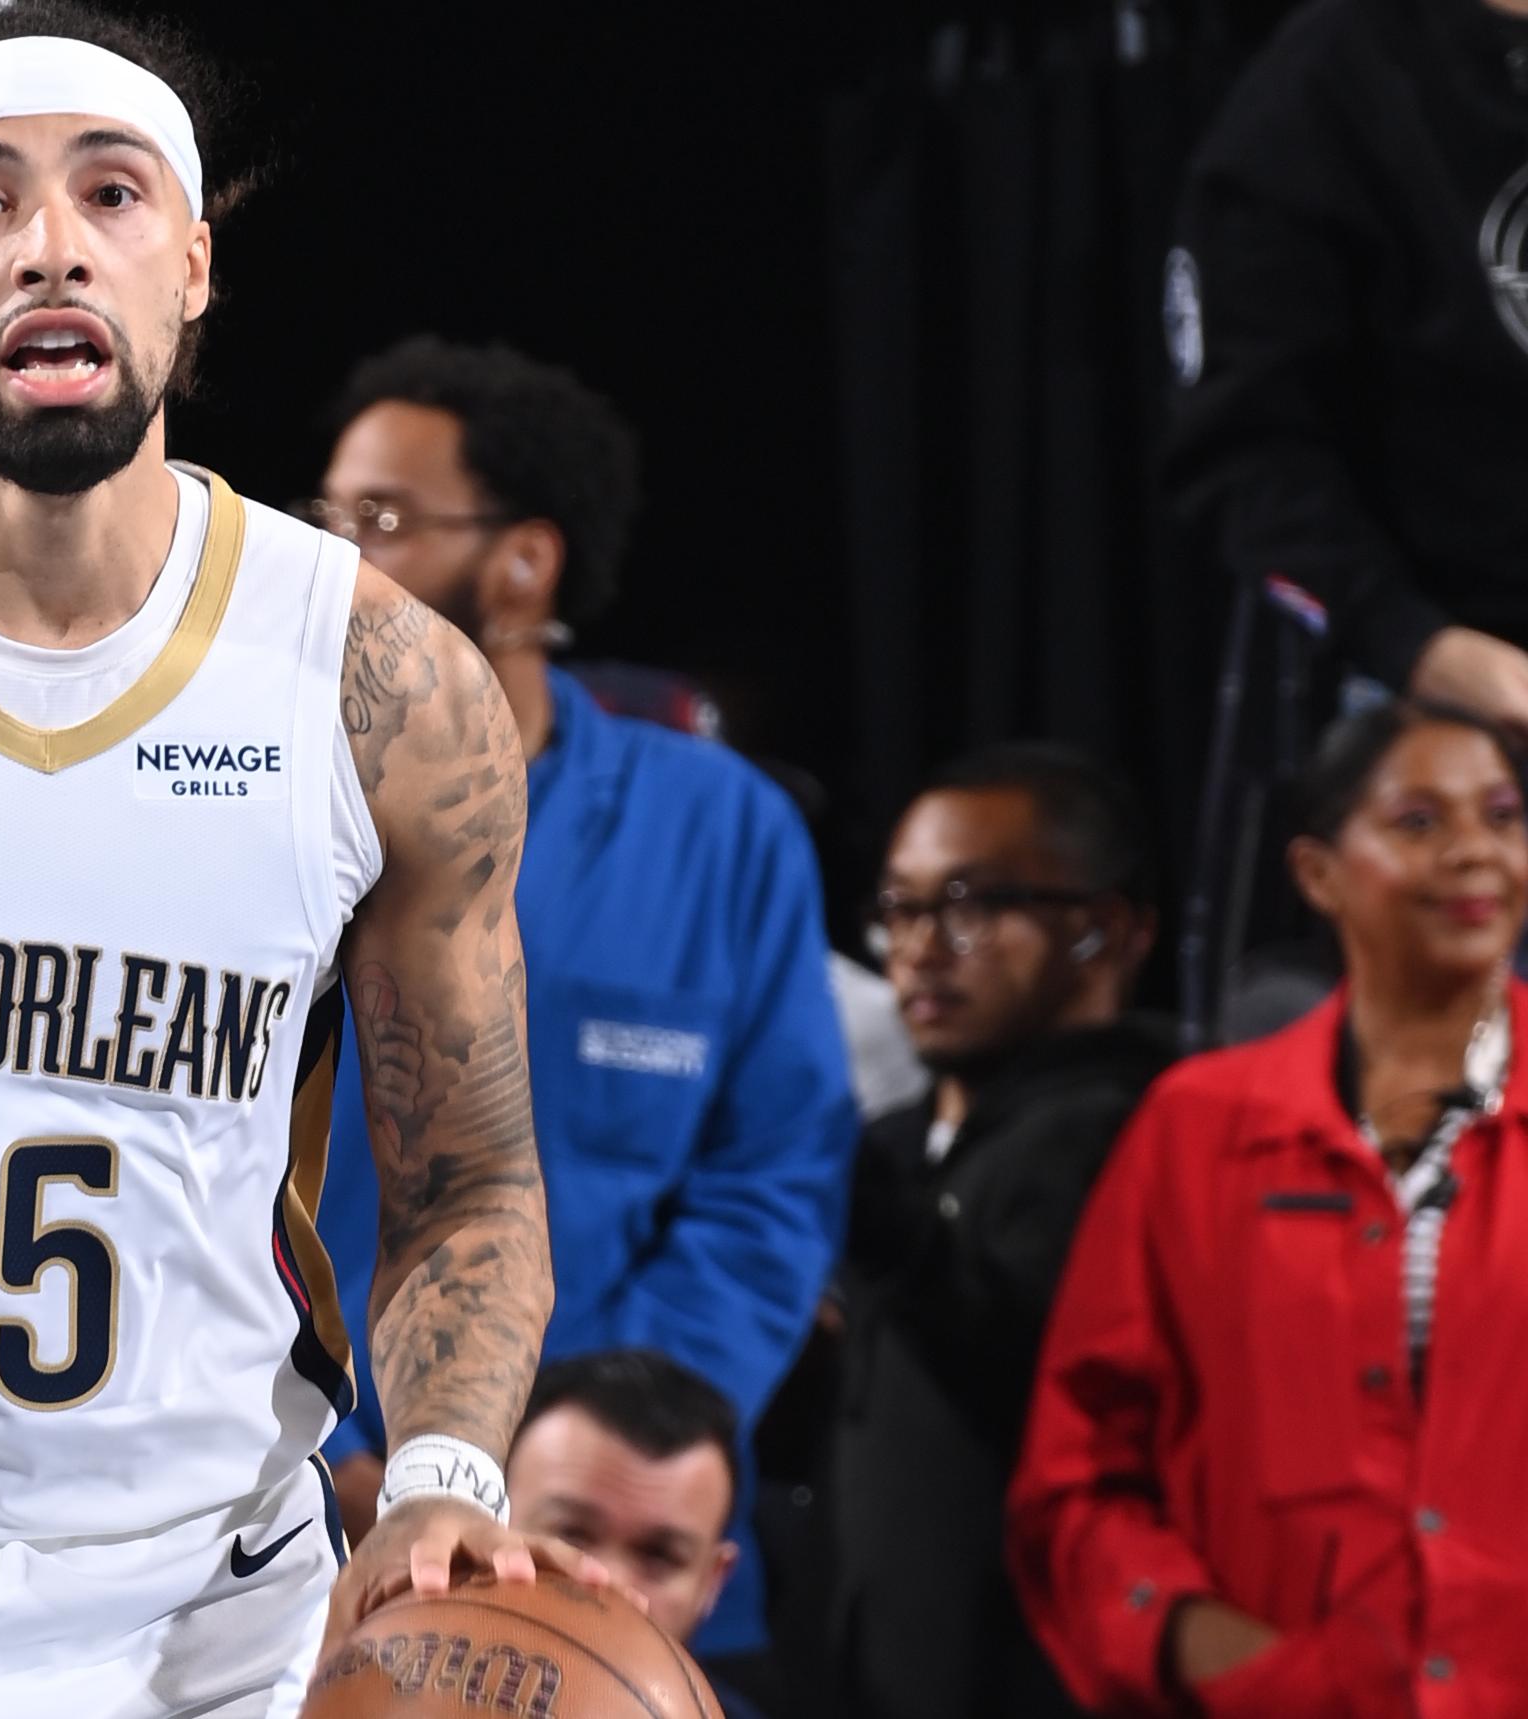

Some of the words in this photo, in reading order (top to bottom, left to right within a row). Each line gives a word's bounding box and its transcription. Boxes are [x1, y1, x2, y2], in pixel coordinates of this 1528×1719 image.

[137, 743, 281, 772] NEWAGE
[171, 780, 248, 797] GRILLS
[315, 1631, 562, 1719] Wils
